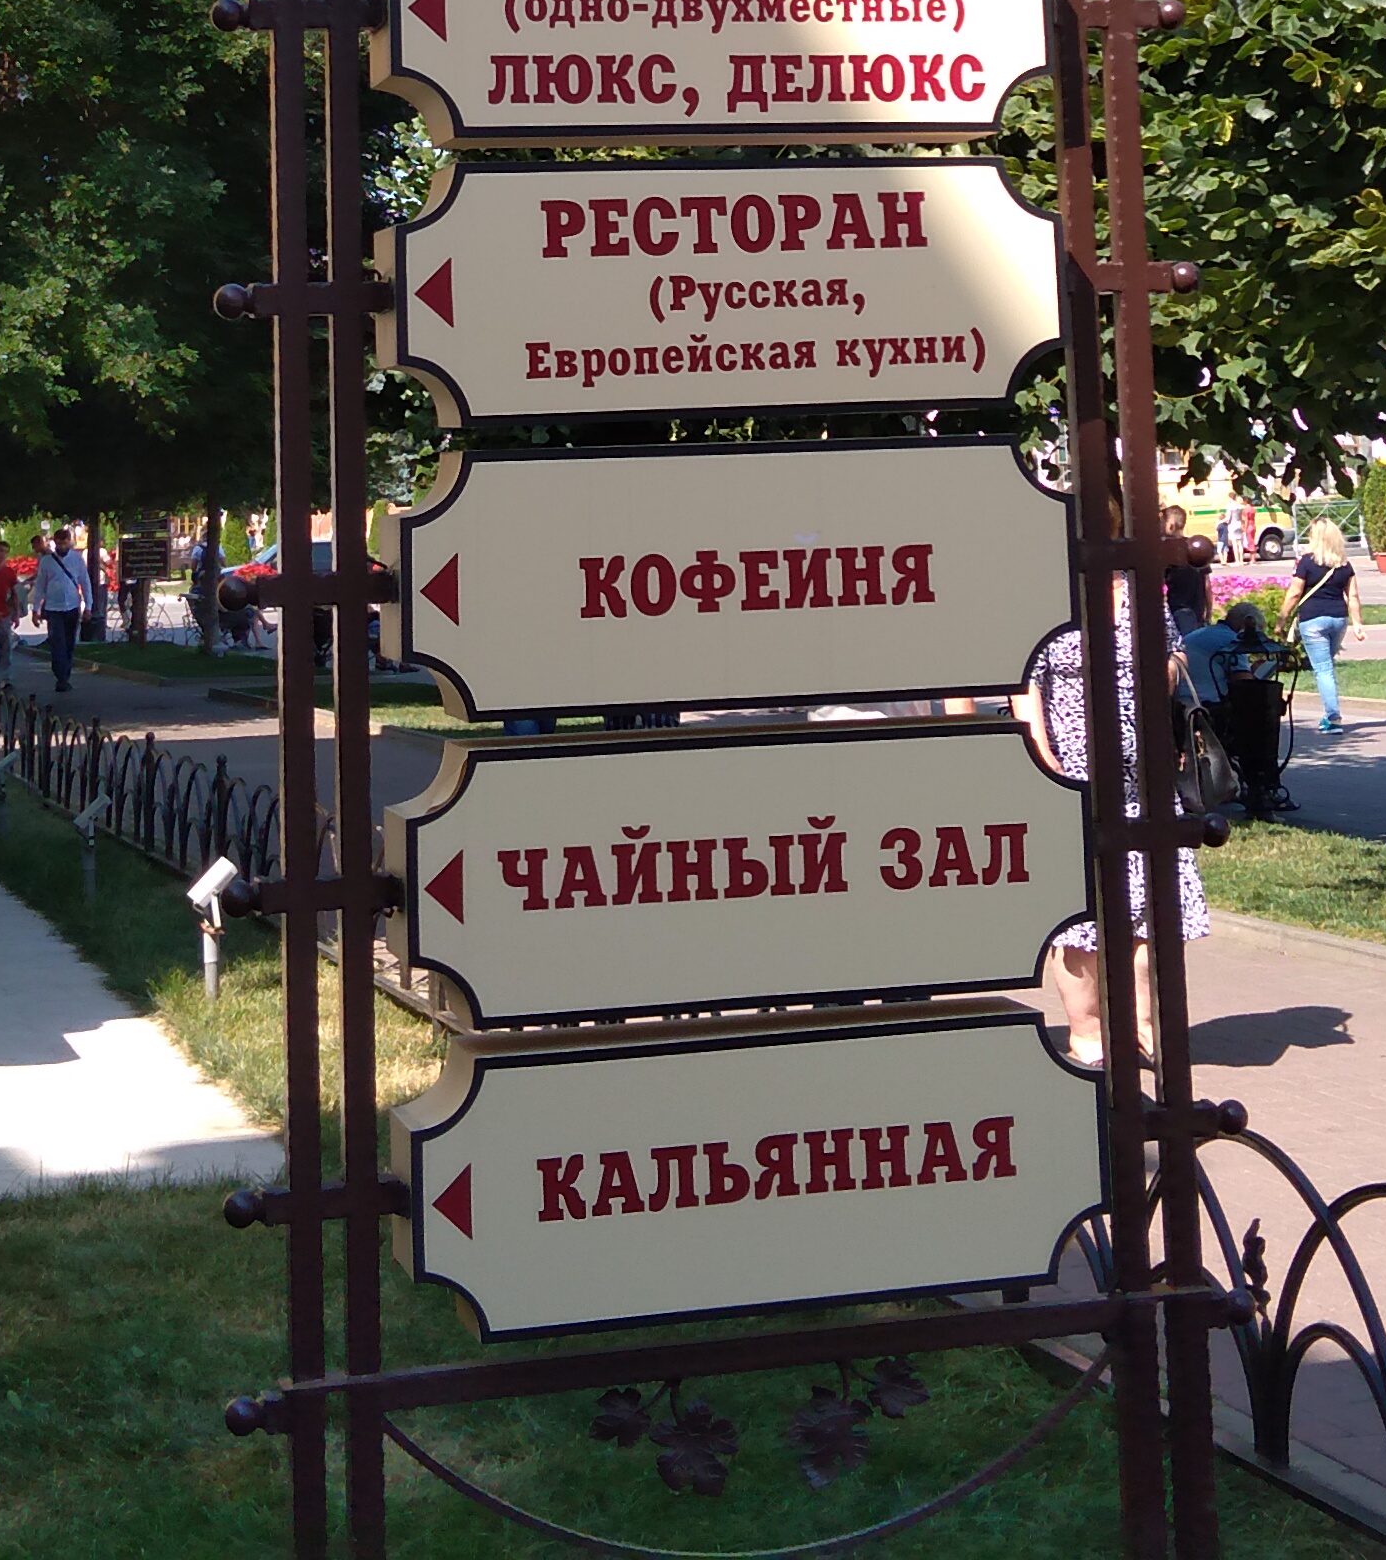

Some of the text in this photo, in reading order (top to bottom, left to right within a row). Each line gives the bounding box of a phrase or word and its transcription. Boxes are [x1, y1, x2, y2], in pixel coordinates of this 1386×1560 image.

[489, 53, 987, 117] ЛЮКС, ДЕЛЮКС
[541, 191, 928, 259] РЕСТОРАН
[649, 274, 867, 323] (Русская,
[525, 327, 987, 388] Европейская кухни)
[498, 815, 1030, 911] ЧАЙНЫЙ ЗАЛ
[537, 1116, 1017, 1222] КАЛЬЯННАЯ
